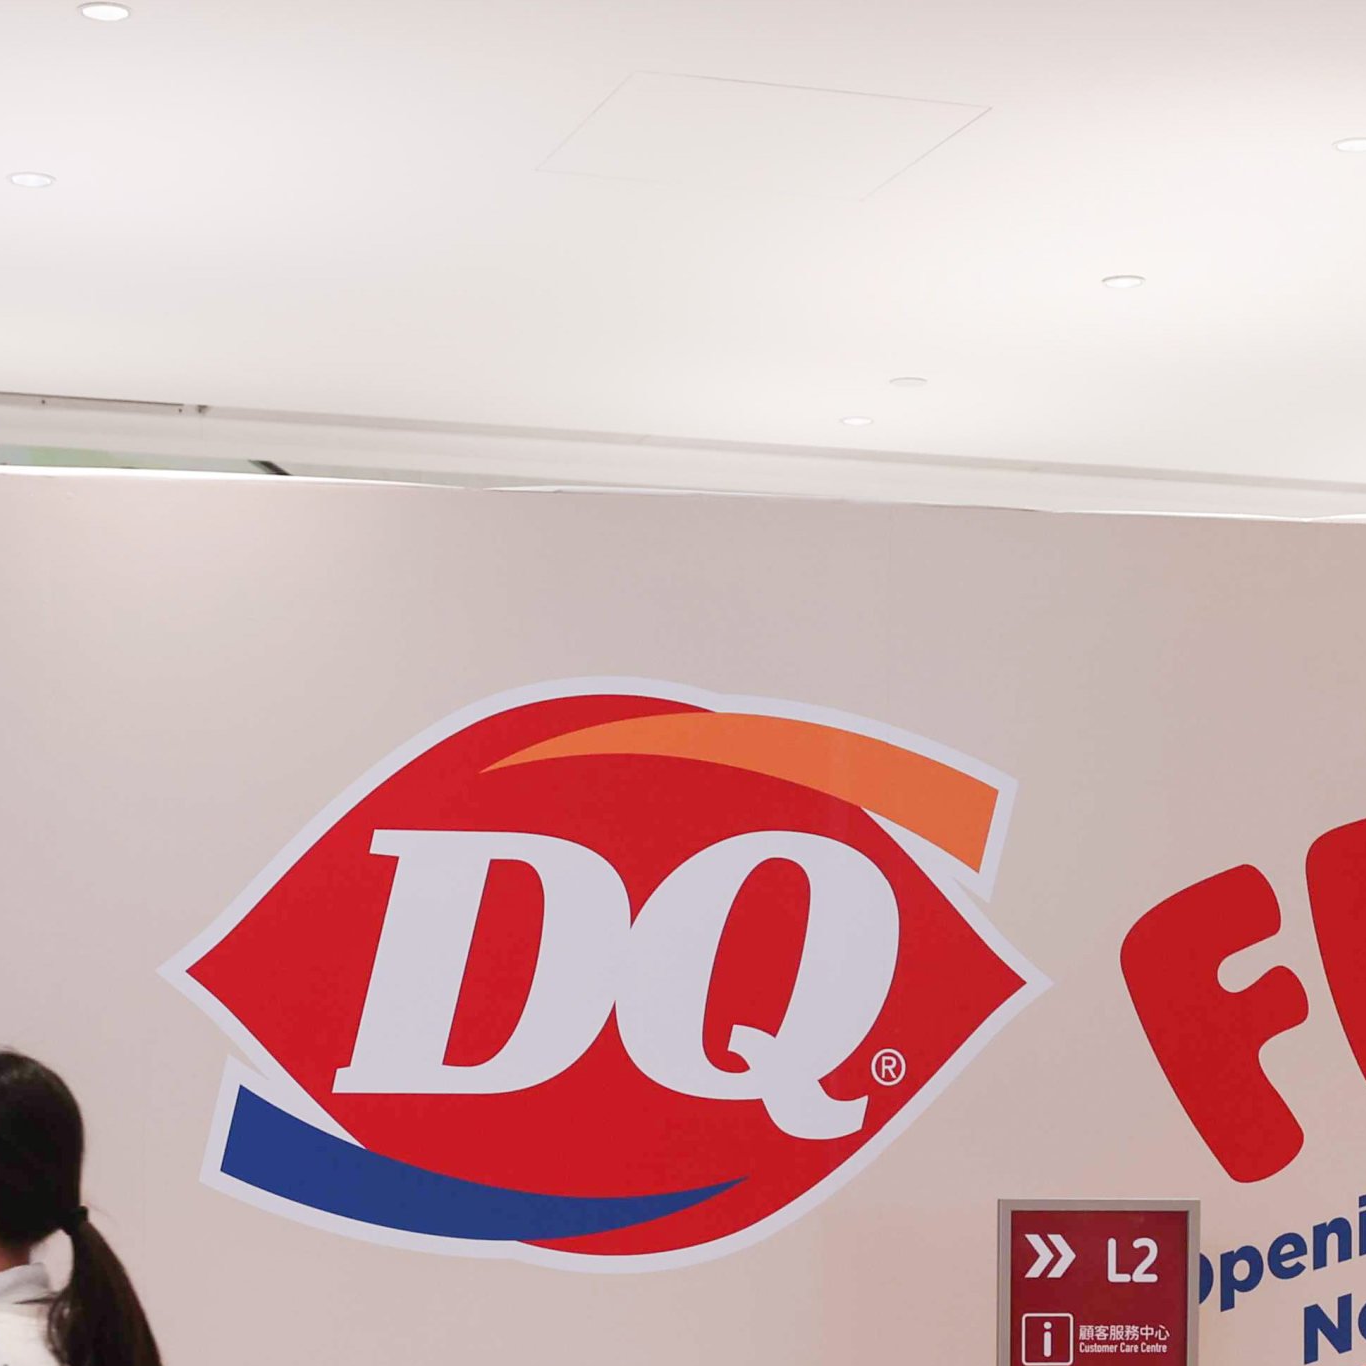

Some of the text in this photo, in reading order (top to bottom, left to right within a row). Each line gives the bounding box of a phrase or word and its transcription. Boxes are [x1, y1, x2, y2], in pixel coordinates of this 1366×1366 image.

[331, 828, 901, 1141] DQ
[1107, 1237, 1159, 1283] L2
[1078, 1324, 1171, 1341] 顧客服務中心
[1079, 1341, 1168, 1354] Customer Care Centre
